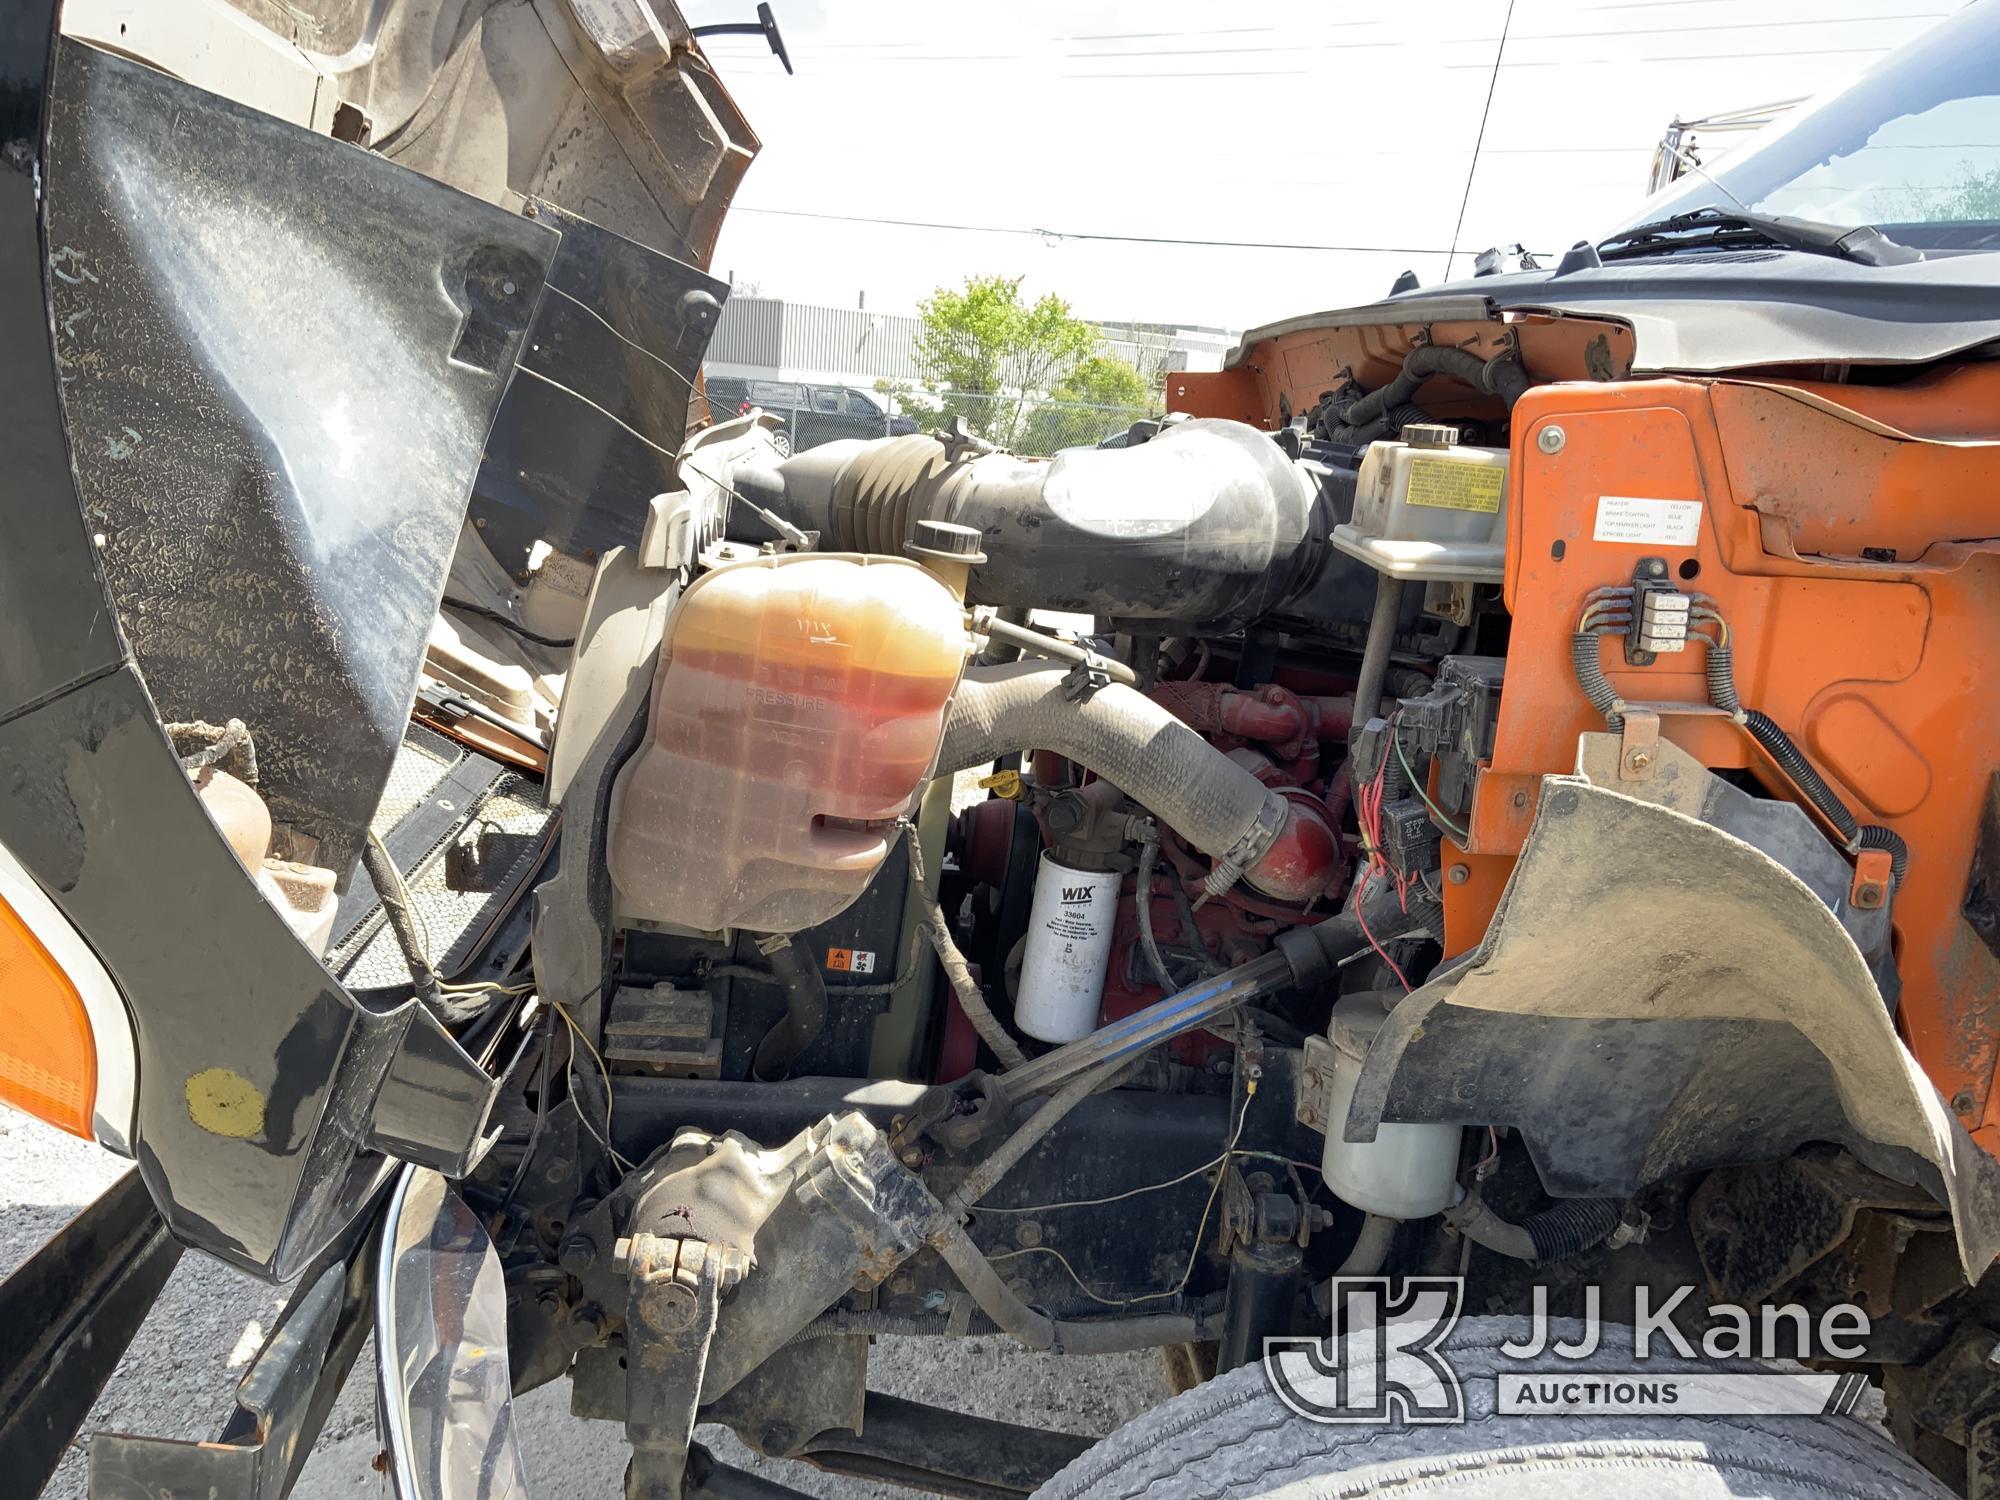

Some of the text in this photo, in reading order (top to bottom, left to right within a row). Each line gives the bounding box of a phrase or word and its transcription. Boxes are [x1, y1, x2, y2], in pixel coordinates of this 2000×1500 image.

[1624, 511, 1650, 519] CONTROL
[745, 687, 825, 712] PRESSURE
[1062, 885, 1094, 901] WIX
[1063, 910, 1085, 920] 33604
